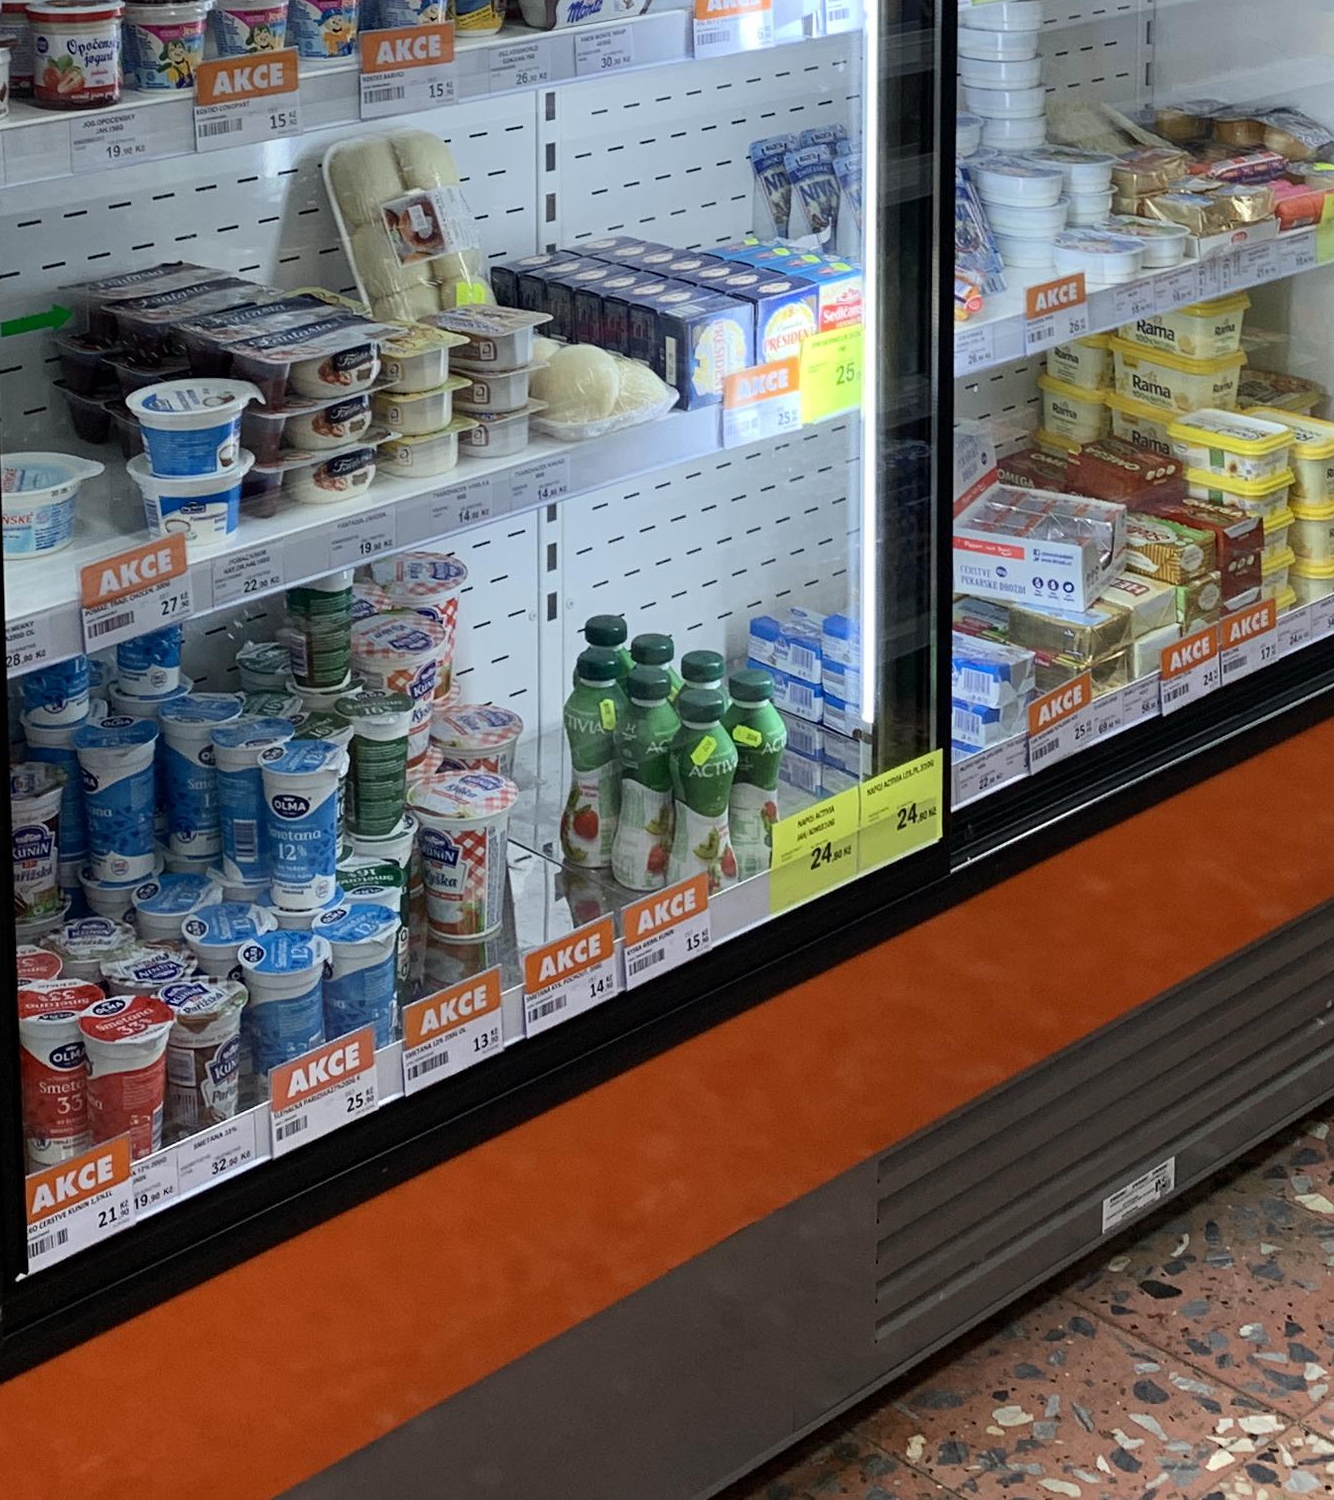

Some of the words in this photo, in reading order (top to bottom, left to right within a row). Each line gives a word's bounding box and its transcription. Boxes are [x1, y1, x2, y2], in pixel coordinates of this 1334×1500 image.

[376, 33, 442, 67] AKCE
[212, 61, 284, 98] AKCE
[429, 82, 445, 99] 15
[270, 112, 287, 130] 15
[1034, 283, 1079, 311] AKCE
[1135, 317, 1176, 342] Rama
[737, 365, 789, 397] AKCE
[1131, 374, 1172, 400] Rama
[1131, 430, 1171, 455] Rama
[99, 548, 172, 596] AKCE
[161, 597, 177, 615] 27
[1229, 609, 1270, 642] AKCE
[1169, 637, 1211, 672] AKCE
[1037, 686, 1084, 726] AKCE
[274, 801, 306, 812] OLMA
[638, 888, 696, 935] AKCE
[686, 934, 700, 952] 15
[539, 933, 601, 982] AKCE
[590, 980, 604, 998] 14
[95, 1007, 154, 1032] Smetana
[96, 1000, 124, 1014] OLMA
[420, 985, 487, 1036] AKCE
[473, 1033, 489, 1052] 13
[287, 1042, 360, 1098] AKCE
[346, 1093, 364, 1112] 25
[31, 1155, 114, 1215] AKCE
[98, 1207, 118, 1228] 21
